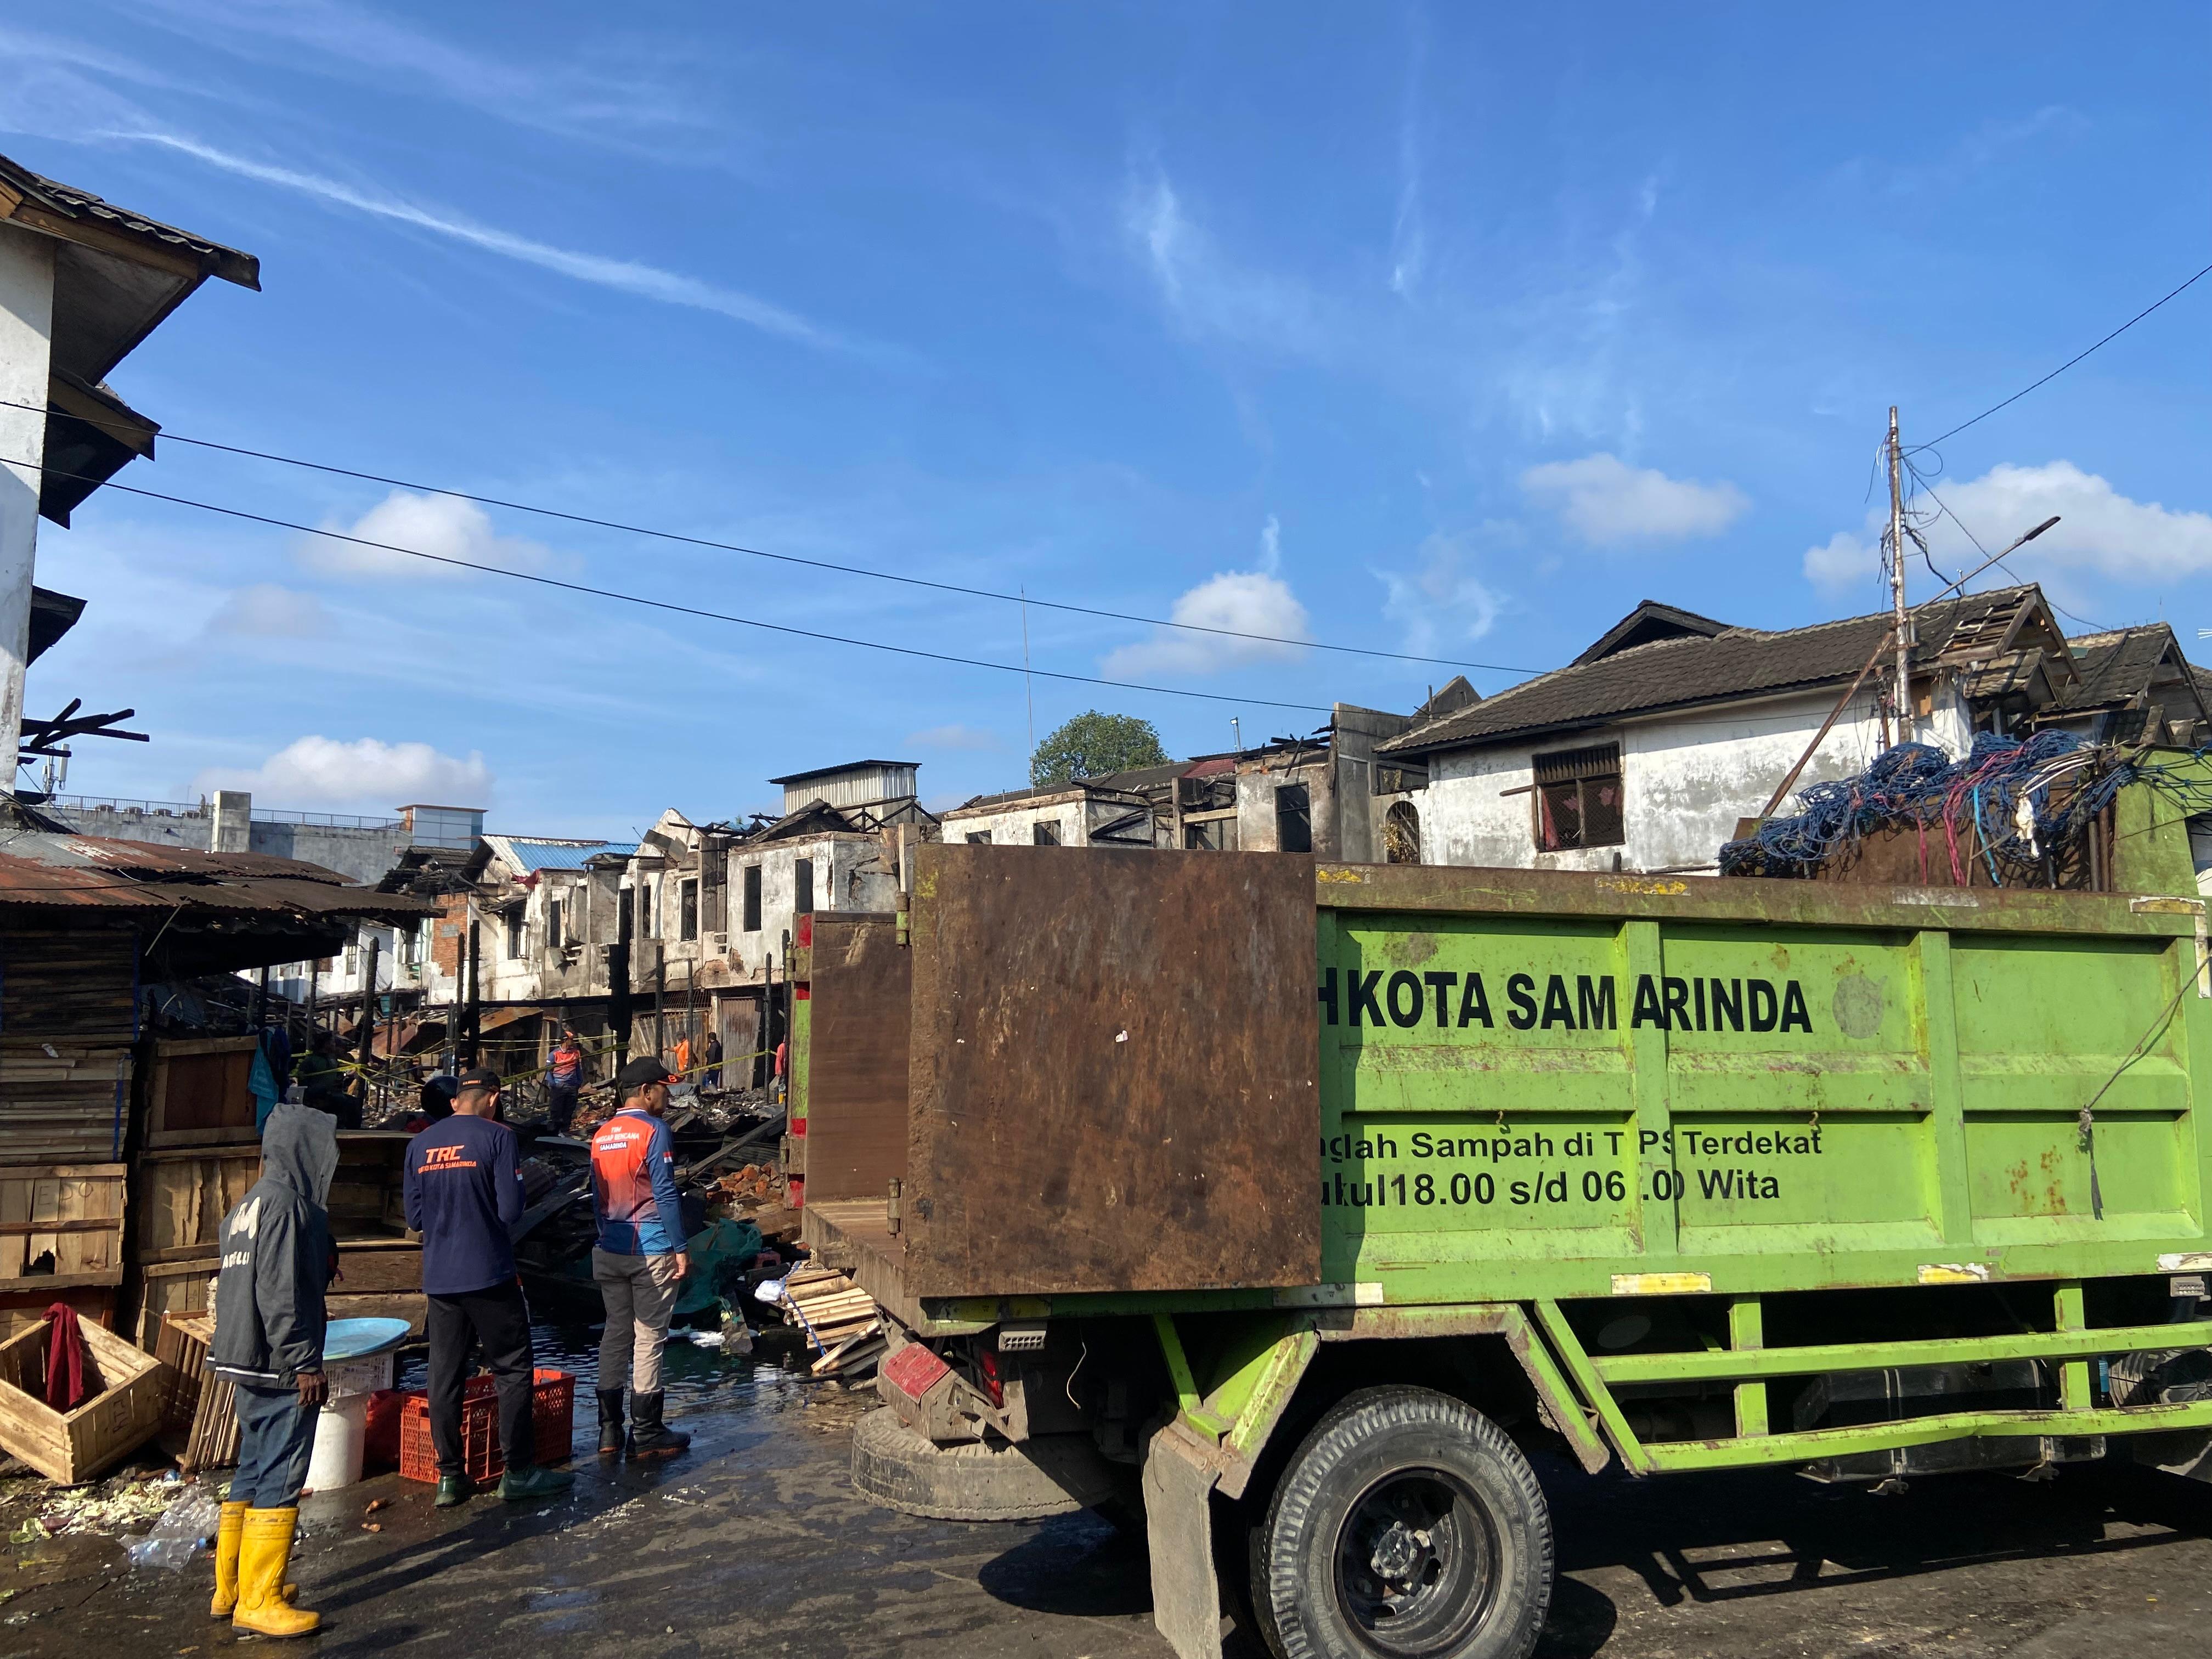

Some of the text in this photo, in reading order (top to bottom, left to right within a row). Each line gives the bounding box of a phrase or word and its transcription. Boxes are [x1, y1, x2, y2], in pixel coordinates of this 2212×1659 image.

[426, 1144, 465, 1164] TRC
[600, 1141, 627, 1151] SAMARINDA
[1412, 1132, 1553, 1164] Sampah
[1564, 1131, 1593, 1157] di
[1681, 1128, 1822, 1155] Terdekat
[1510, 1171, 1568, 1204] s/d
[1583, 1169, 1685, 1203] 06.00
[1699, 1169, 1780, 1200] Wita
[1479, 1466, 1519, 1519] SUPER
[1511, 1523, 1529, 1601] MIGHTY
